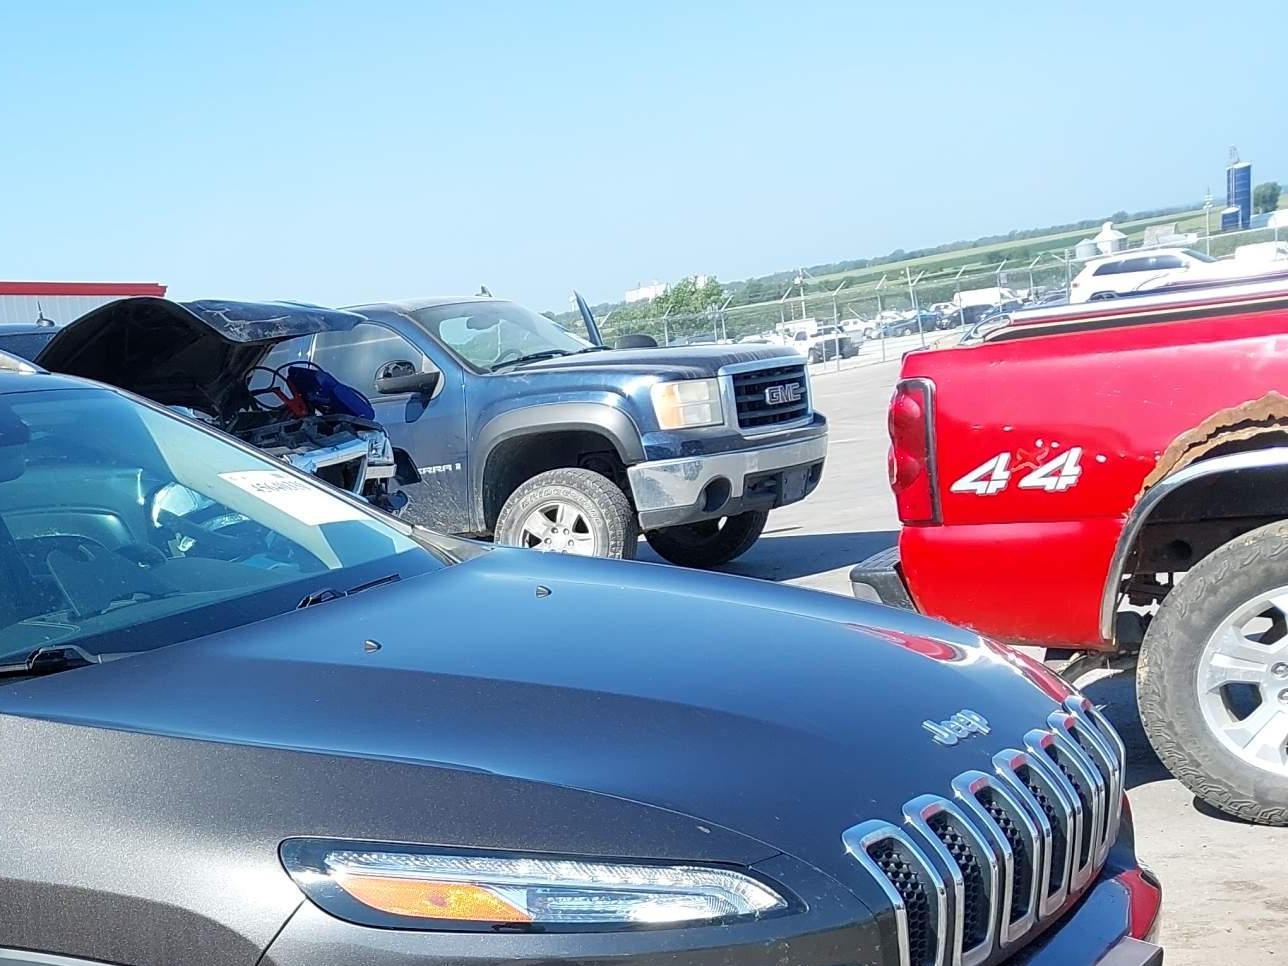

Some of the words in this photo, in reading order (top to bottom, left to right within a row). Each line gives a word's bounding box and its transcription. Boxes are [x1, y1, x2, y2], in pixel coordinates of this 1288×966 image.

[764, 382, 802, 405] GMC
[416, 464, 453, 475] ERRA
[921, 708, 992, 746] Jeep
